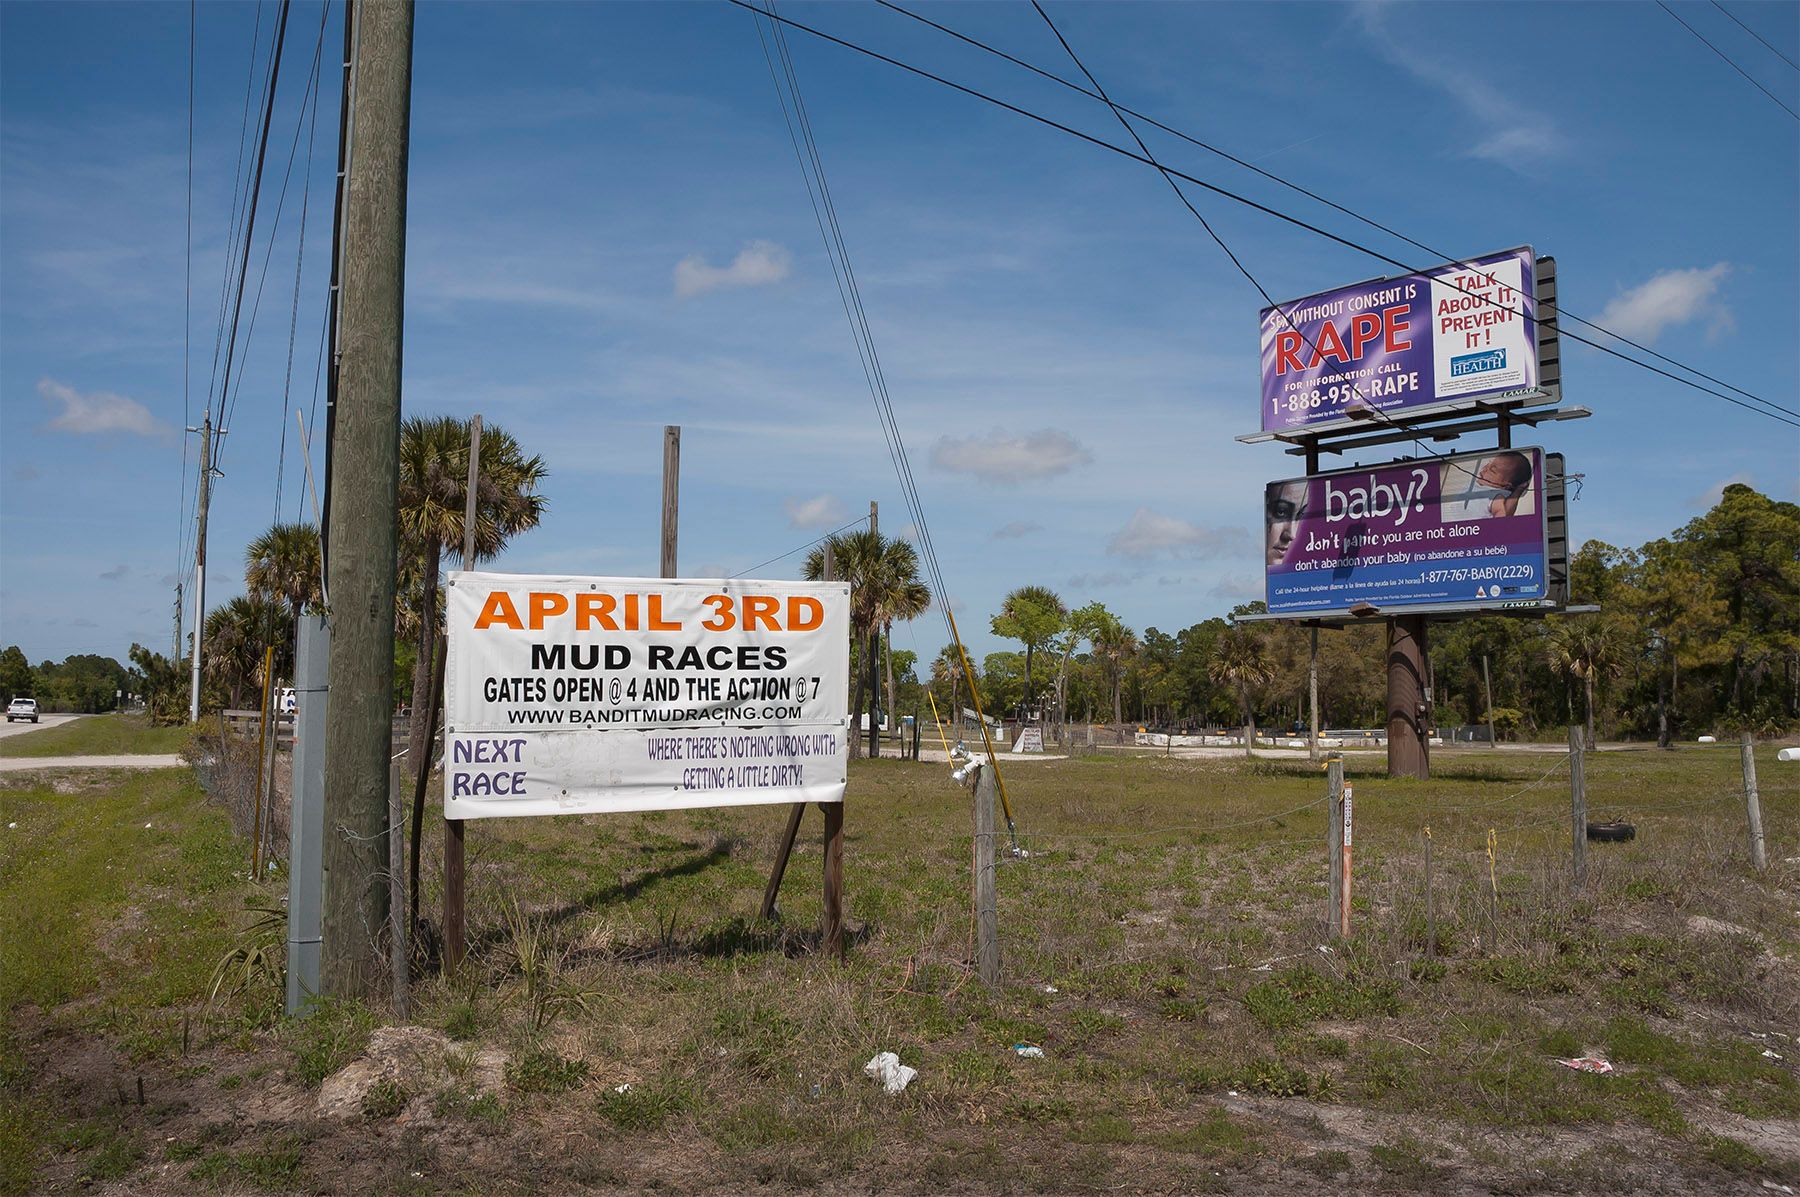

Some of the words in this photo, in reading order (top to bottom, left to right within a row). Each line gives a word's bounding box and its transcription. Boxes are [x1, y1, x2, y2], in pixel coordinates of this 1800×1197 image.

[1454, 272, 1497, 293] TALK
[1270, 315, 1289, 329] SEX
[1292, 301, 1344, 324] WITHOUT
[1348, 288, 1401, 313] CONSENT
[1405, 284, 1416, 299] IS
[1438, 292, 1492, 316] ABOUT
[1441, 307, 1515, 334] PREVENT
[1275, 304, 1412, 376] RAPE
[1285, 382, 1302, 392] FOR
[1306, 369, 1374, 387] INFORMATION
[1378, 362, 1401, 374] CALL
[1453, 357, 1502, 375] HEALTH
[1272, 372, 1418, 415] 1-888-956-RAPE
[1503, 388, 1536, 398] LAMAR
[1325, 468, 1428, 526] baby?
[1306, 531, 1340, 552] don't
[1344, 528, 1379, 554] panic
[1382, 530, 1402, 546] you
[1405, 530, 1423, 542] are
[1426, 527, 1445, 539] not
[1448, 525, 1480, 538] alone
[1295, 560, 1319, 572] don't
[1321, 556, 1360, 569] abandon
[1363, 554, 1383, 568] your
[1387, 553, 1411, 565] baby
[1414, 552, 1426, 562] (no
[1428, 549, 1464, 560] abandone
[1420, 565, 1534, 584] 1-877-767-BABY(2229)
[473, 591, 682, 631] APRIL
[701, 594, 824, 632] 3RD
[531, 644, 632, 670] MUD
[648, 646, 787, 670] RACES
[484, 677, 546, 702] GATES
[553, 677, 603, 702] OPEN
[608, 677, 622, 705] @
[626, 678, 637, 702] 4
[642, 677, 680, 702] AND
[686, 677, 720, 701] THE
[727, 676, 790, 701] ACTION
[794, 676, 807, 704] @
[811, 676, 821, 700] 7
[453, 739, 528, 764] NEXT
[648, 736, 683, 761] WHERE
[686, 736, 727, 760] THERE'S
[730, 734, 774, 758] NOTHING
[776, 734, 810, 757] WRONG
[812, 734, 836, 756] WITH
[453, 771, 528, 796] RACE
[683, 767, 724, 790] GETTING
[727, 766, 735, 788] A
[737, 765, 770, 788] LITTLE
[771, 764, 804, 787] DIRTY!
